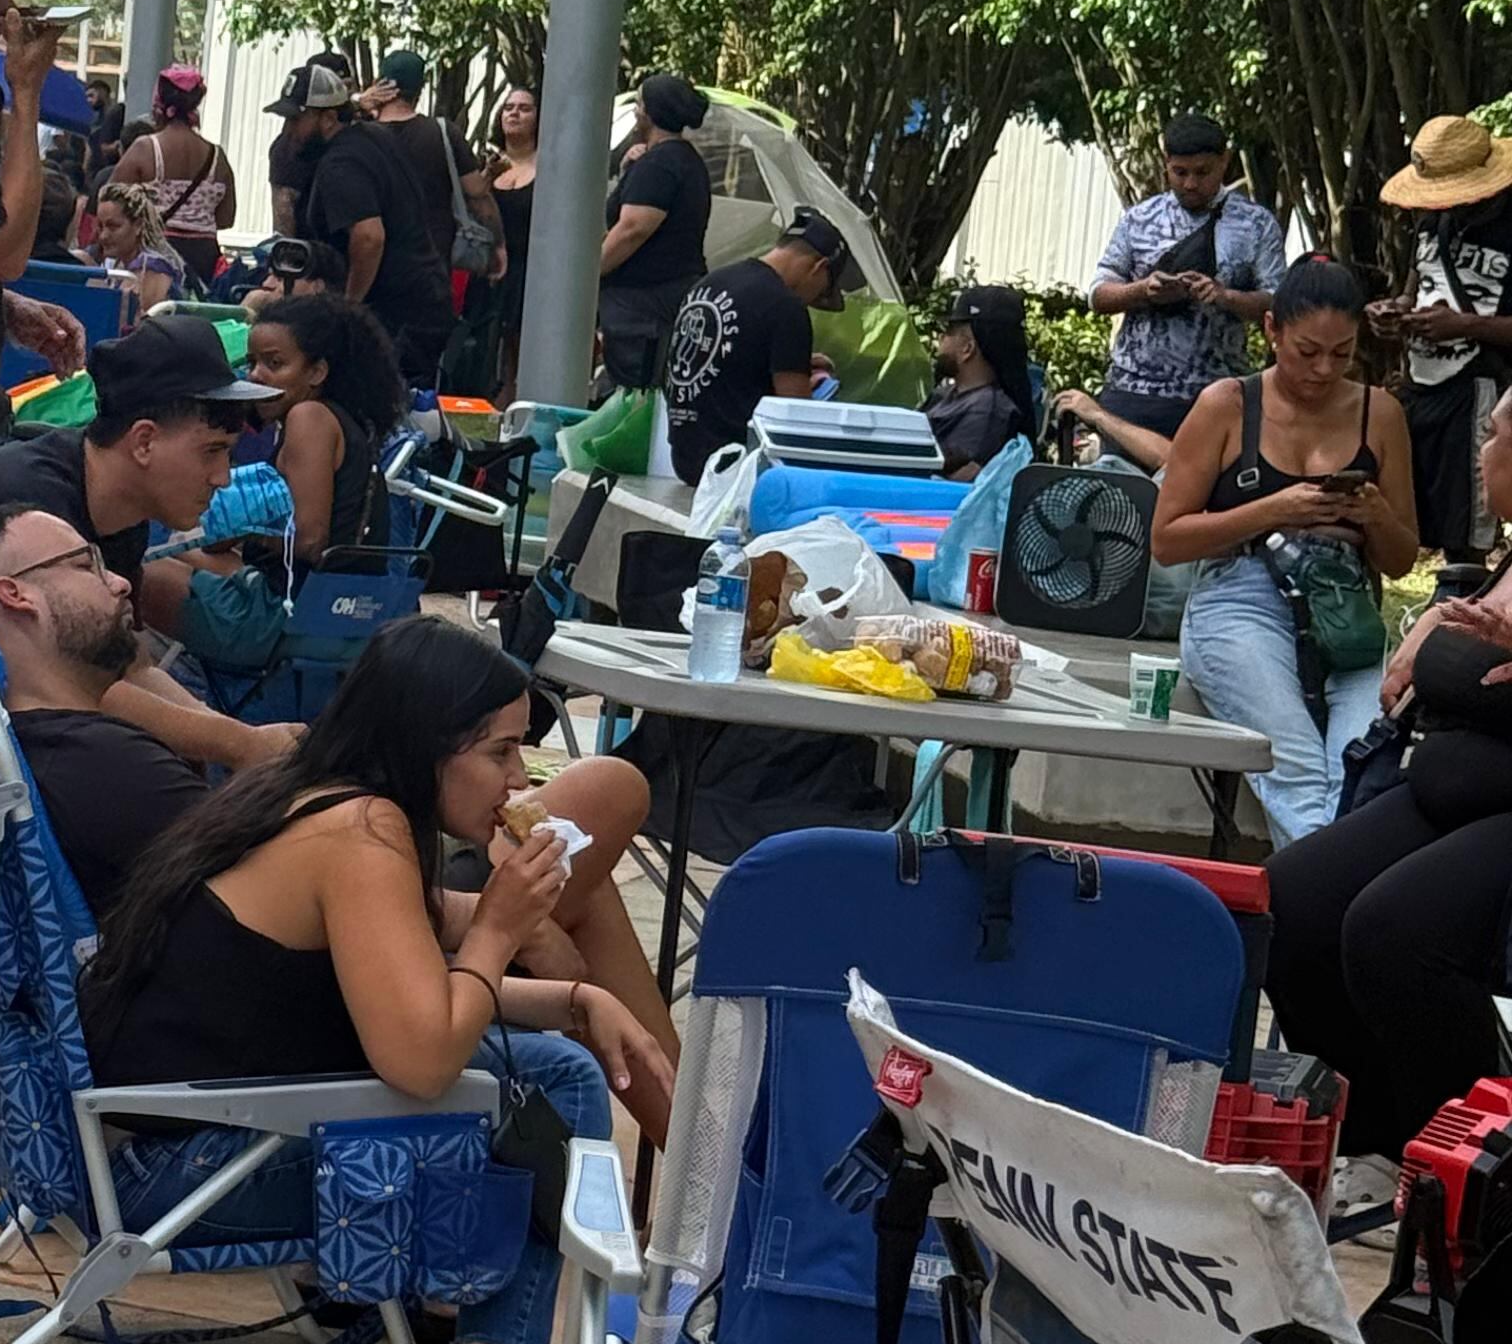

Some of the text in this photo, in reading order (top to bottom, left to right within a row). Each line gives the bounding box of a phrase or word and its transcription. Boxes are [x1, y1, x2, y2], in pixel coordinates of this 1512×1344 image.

[1415, 231, 1510, 278] MFITS
[713, 290, 739, 336] DOGS
[1072, 1199, 1242, 1336] STATE
